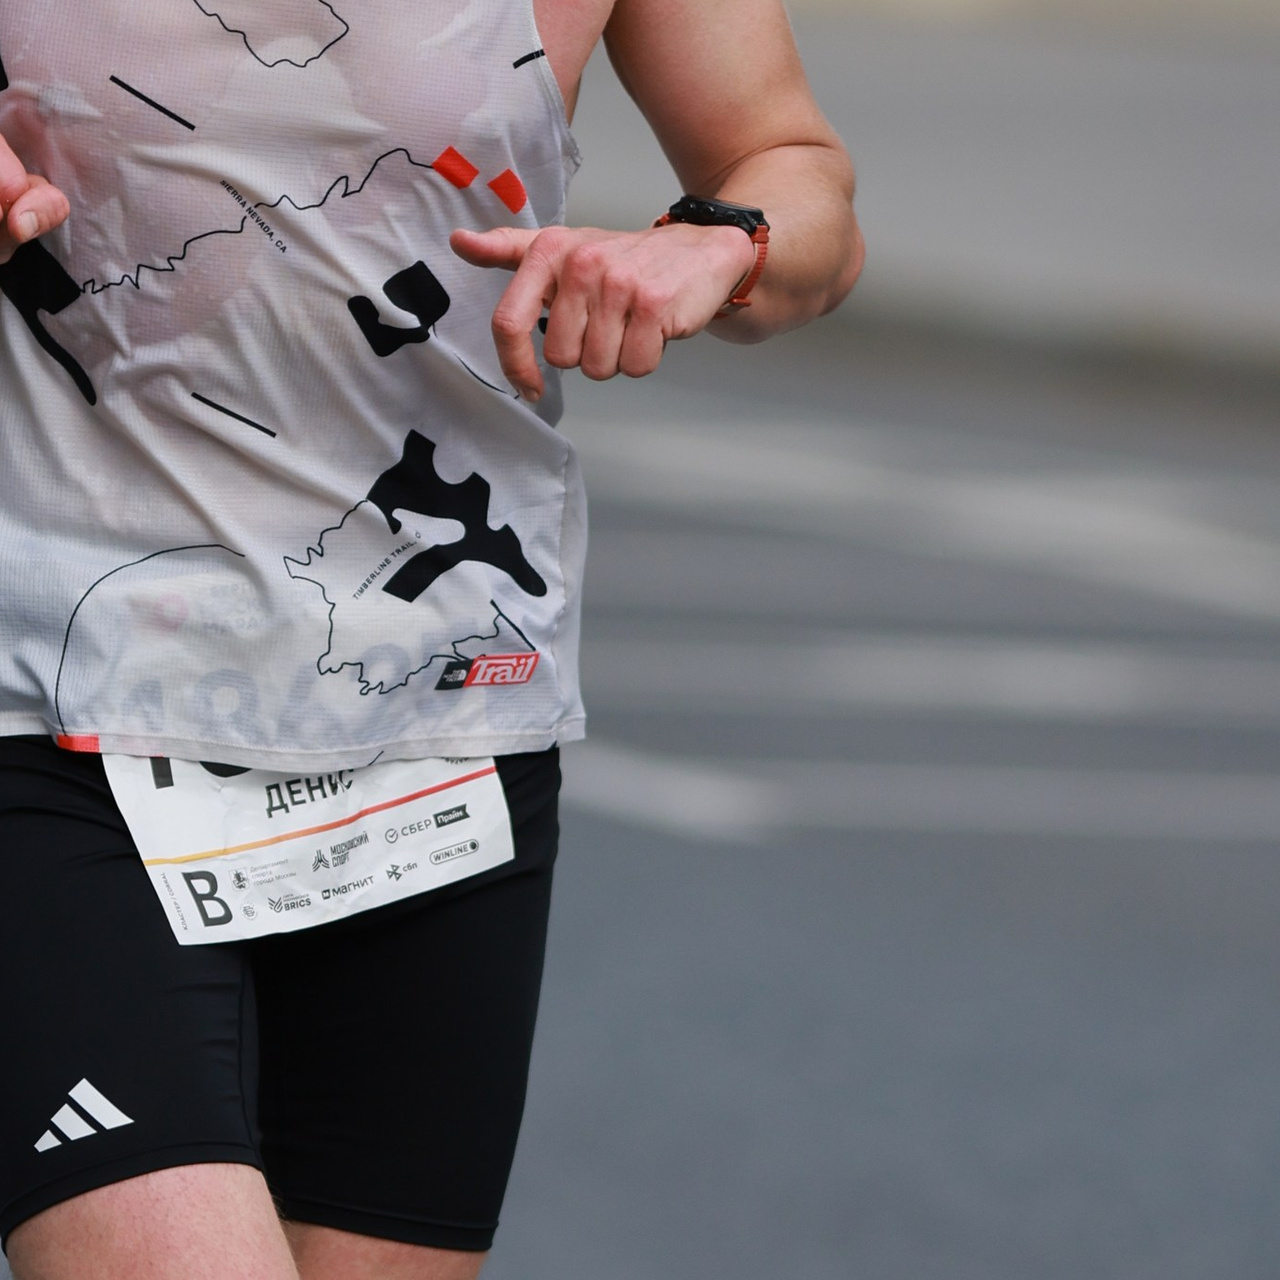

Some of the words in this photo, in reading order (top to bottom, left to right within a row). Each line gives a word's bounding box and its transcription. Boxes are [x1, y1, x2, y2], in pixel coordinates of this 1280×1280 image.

[220, 180, 247, 208] SIERRA
[275, 240, 287, 253] CA
[353, 558, 392, 600] TIMBERLINE
[471, 656, 535, 685] Trail
[401, 819, 432, 836] СБЕР
[433, 844, 468, 861] WINLINE
[181, 870, 233, 928] B
[284, 898, 312, 911] BRICS
